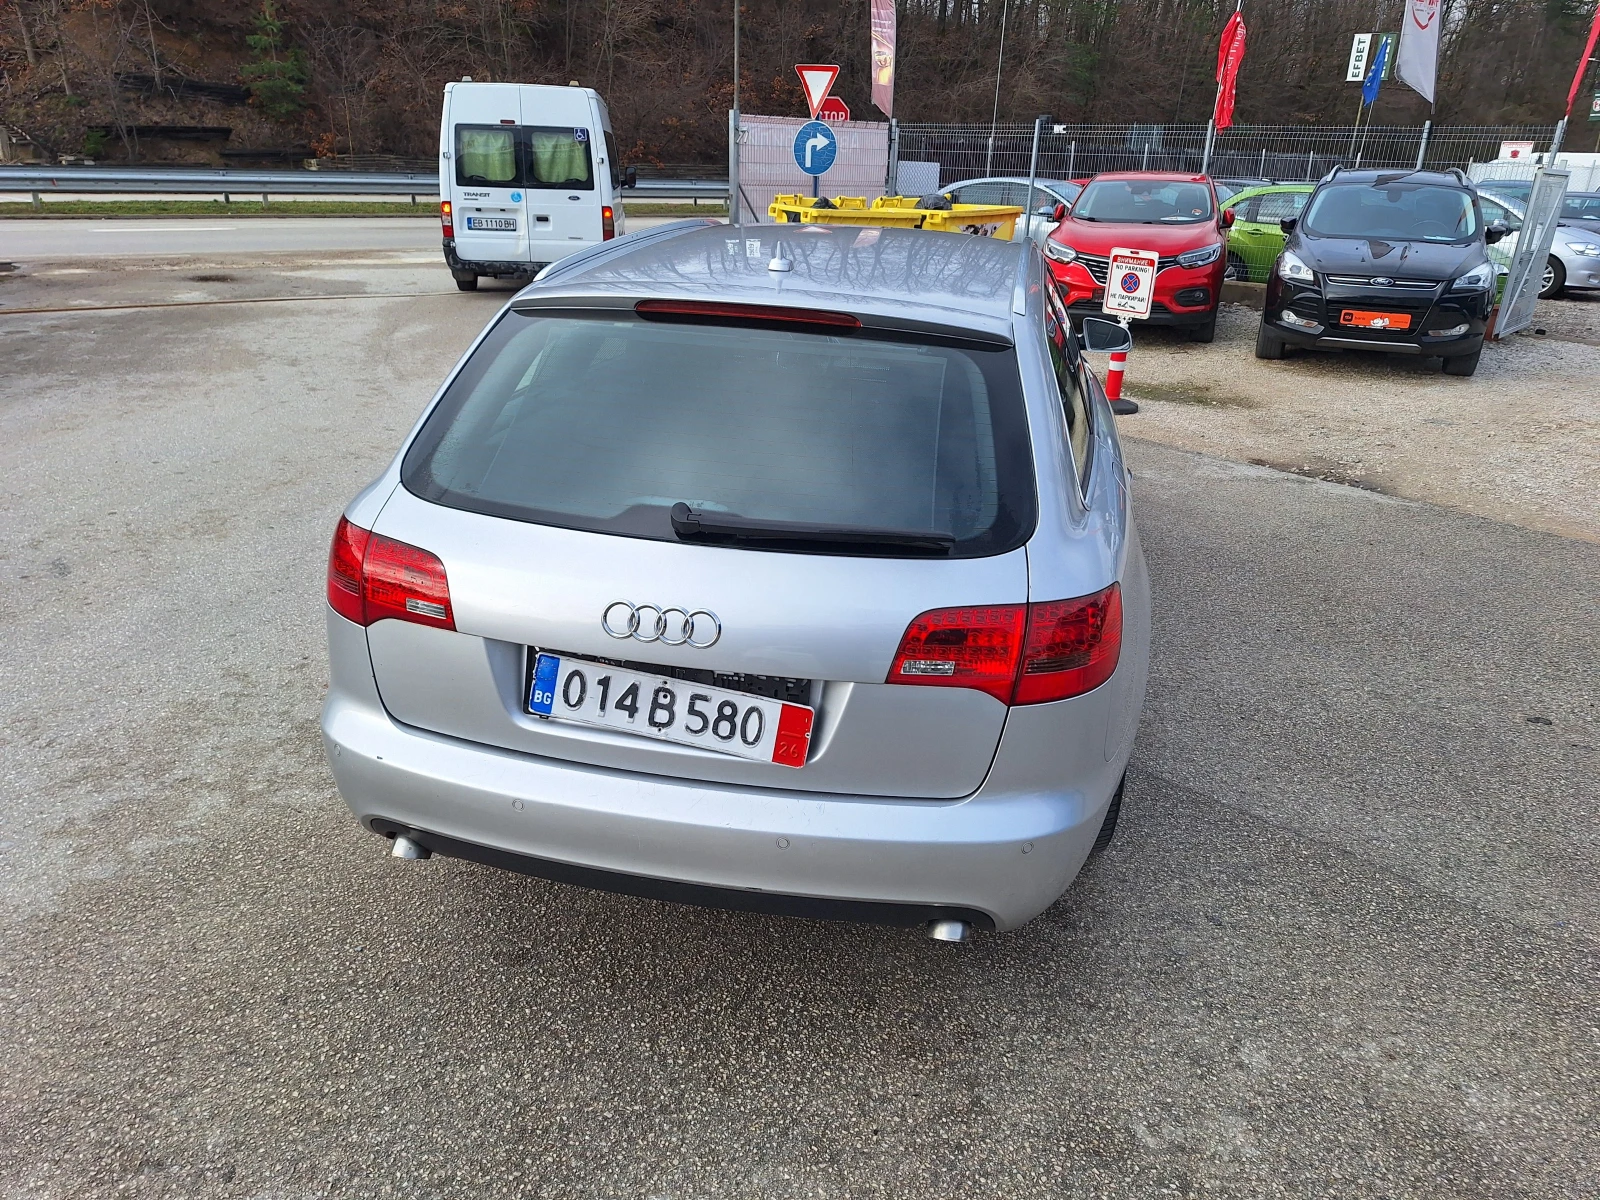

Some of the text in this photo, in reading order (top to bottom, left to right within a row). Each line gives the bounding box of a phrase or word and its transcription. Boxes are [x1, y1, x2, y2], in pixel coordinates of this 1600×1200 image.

[1351, 37, 1367, 78] EFBET
[485, 219, 503, 228] 1110
[1116, 256, 1151, 266] ВНИМАНИЕ!
[1125, 265, 1149, 273] PARKING!
[1118, 294, 1147, 302] ПАРКИРАЙ!
[533, 690, 552, 705] BG
[778, 741, 799, 759] 26
